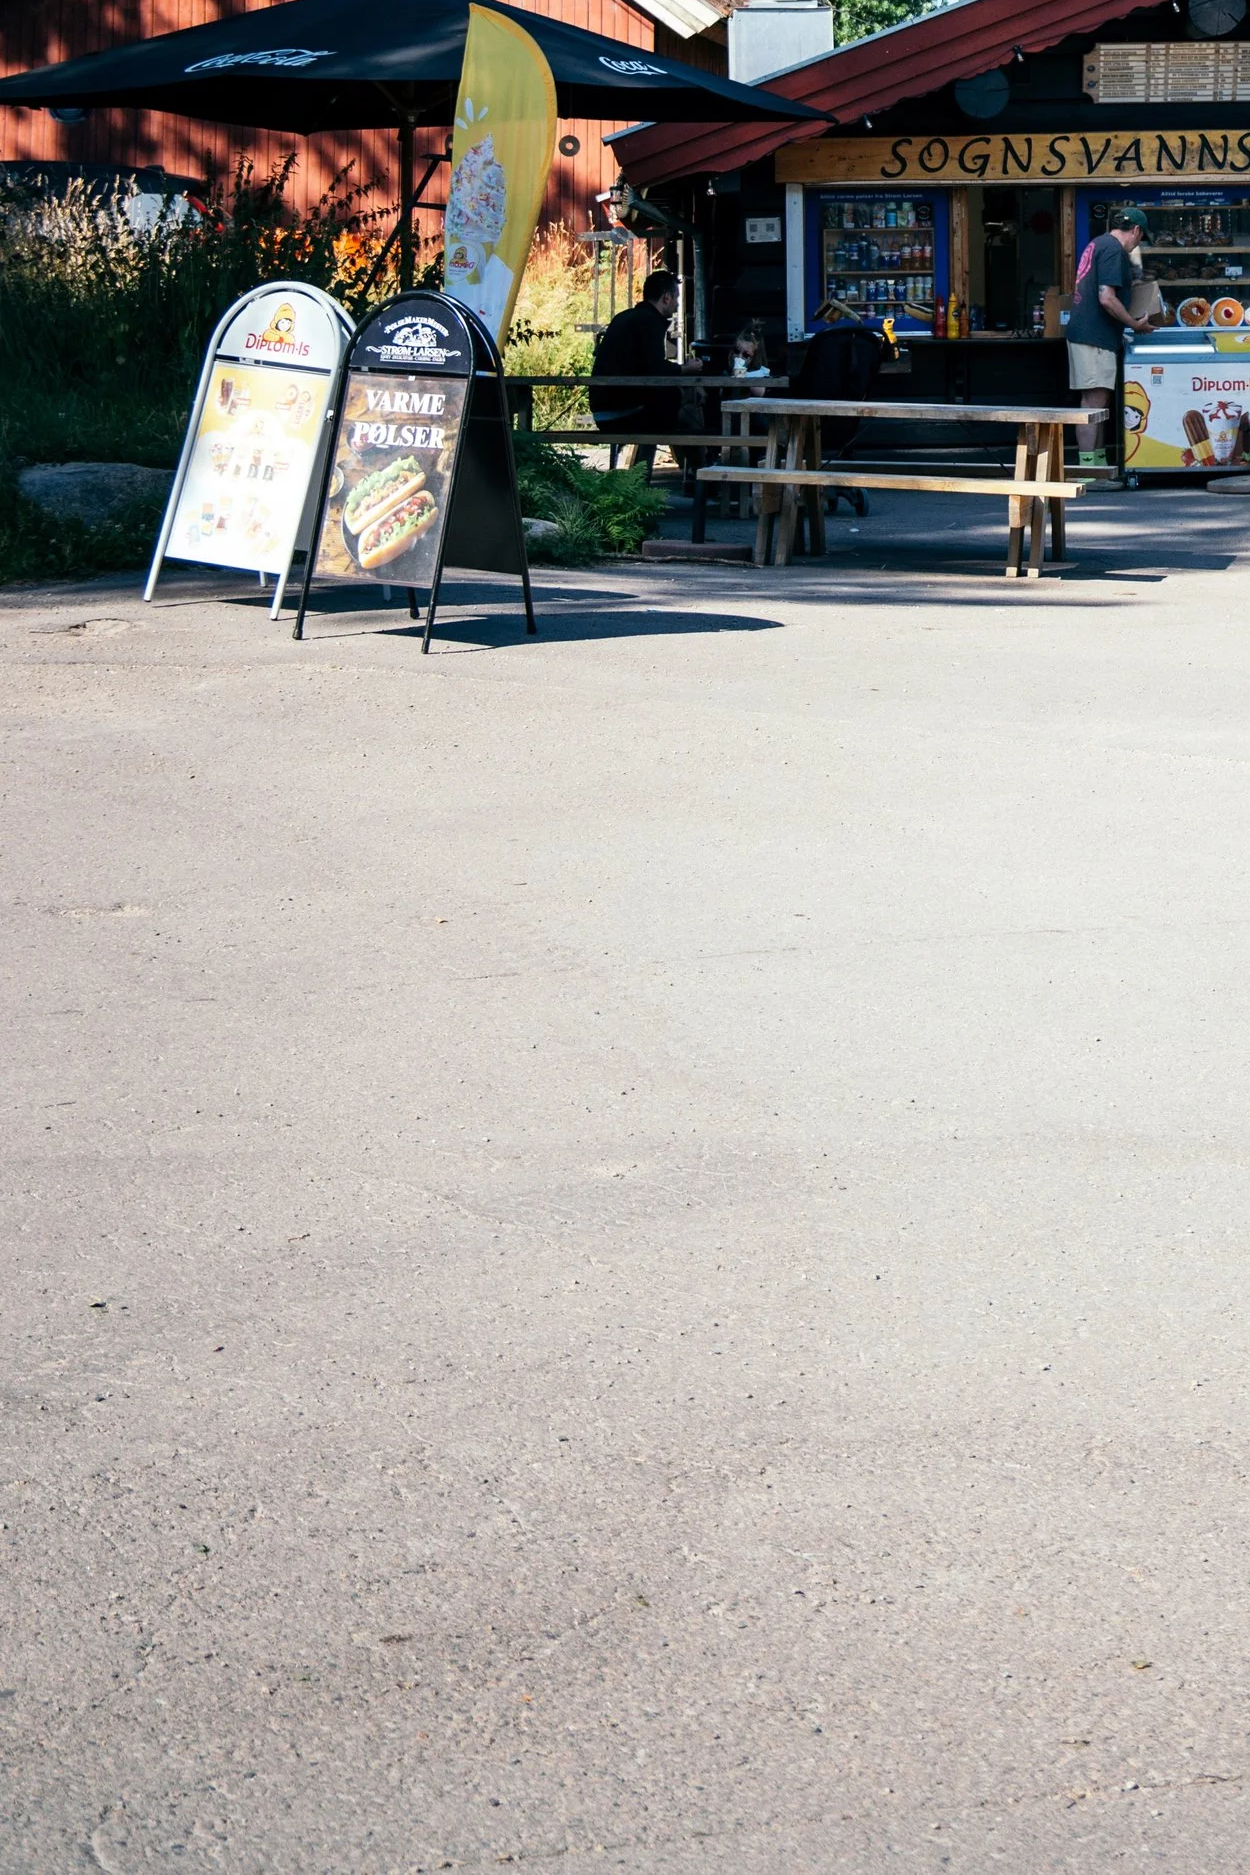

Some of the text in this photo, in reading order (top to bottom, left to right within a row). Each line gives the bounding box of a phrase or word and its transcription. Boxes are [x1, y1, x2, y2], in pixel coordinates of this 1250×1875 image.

[381, 345, 447, 358] STRØM-LARSEN
[366, 389, 446, 415] VARME
[353, 422, 446, 449] PØLSER
